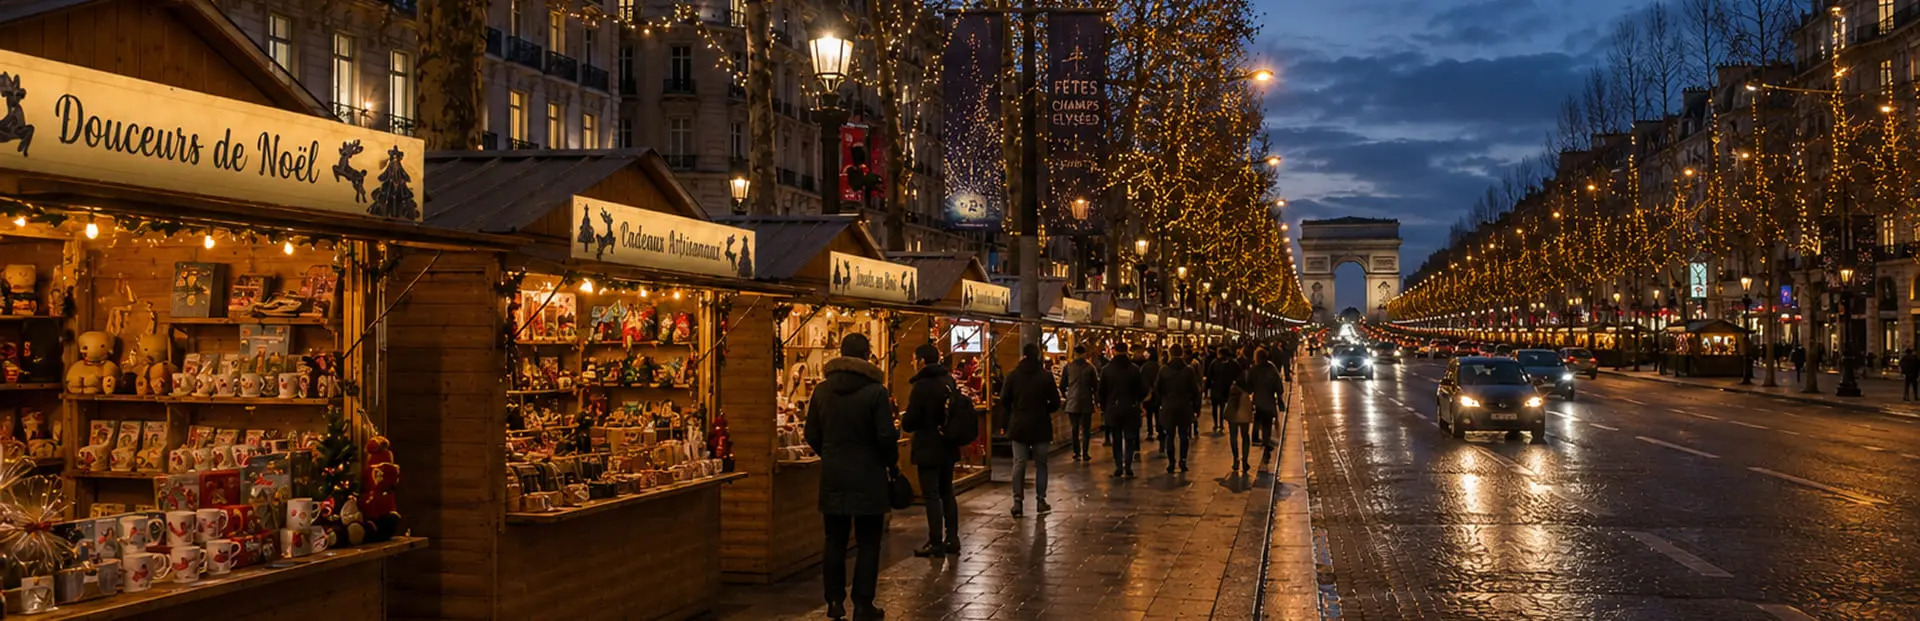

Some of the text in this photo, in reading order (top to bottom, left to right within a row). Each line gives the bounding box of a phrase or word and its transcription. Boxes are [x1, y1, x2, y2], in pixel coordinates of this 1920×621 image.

[55, 93, 320, 184] Douceurs de Noël
[620, 221, 665, 253] Cadeaux
